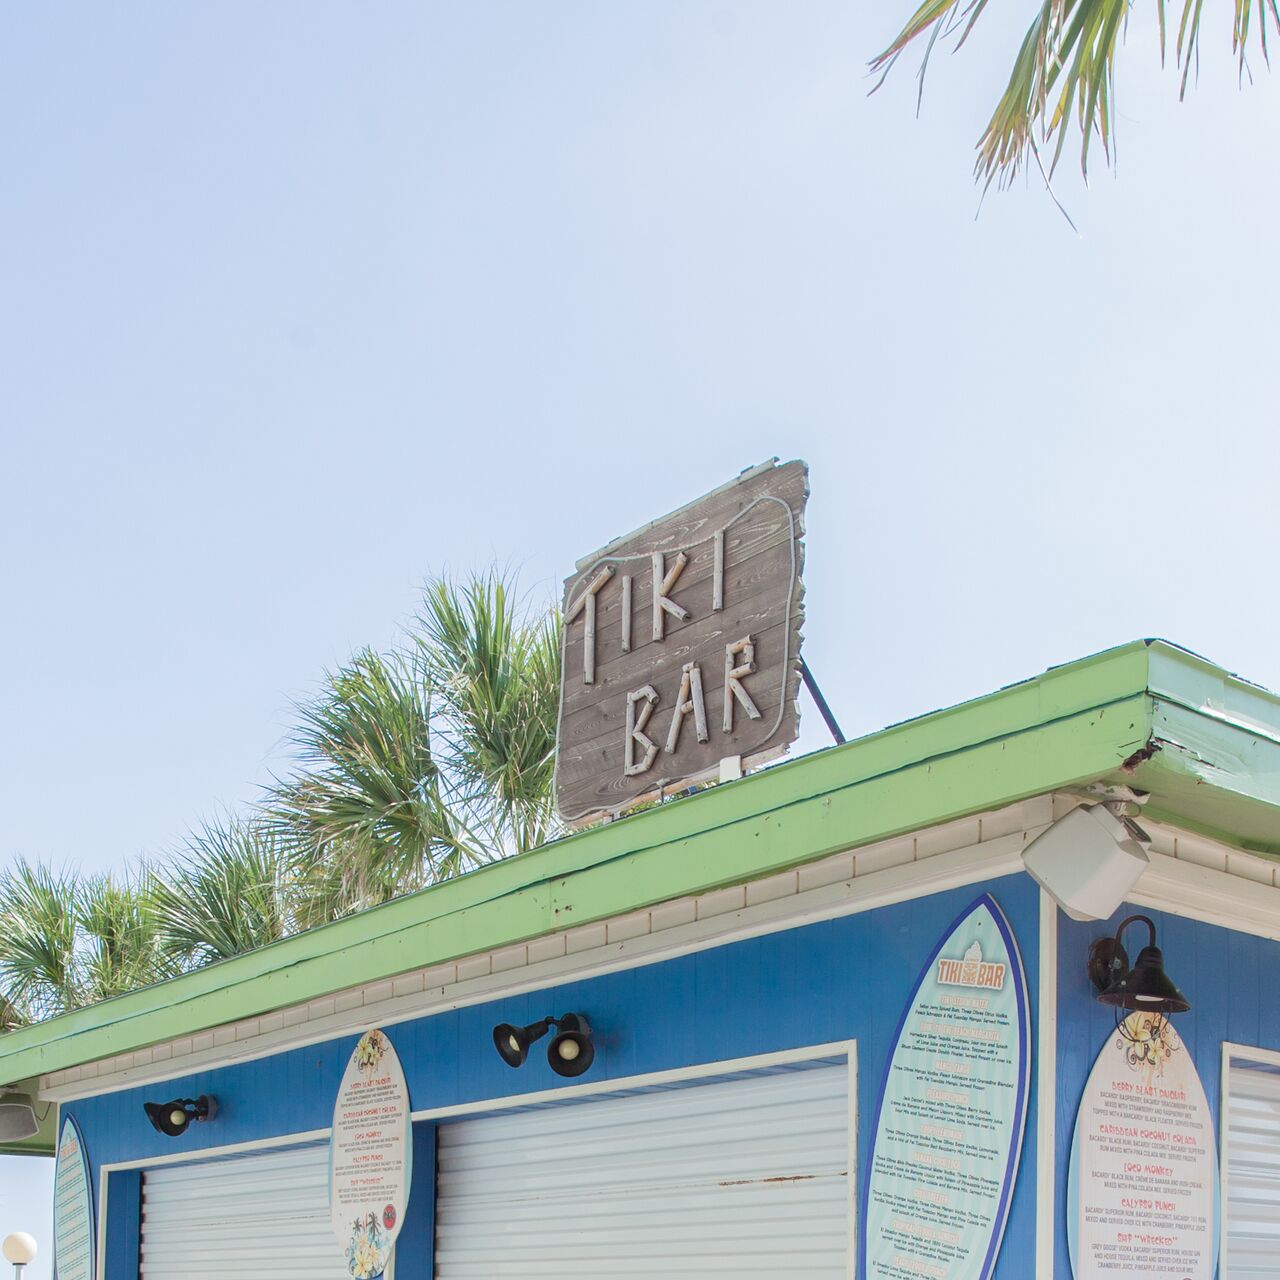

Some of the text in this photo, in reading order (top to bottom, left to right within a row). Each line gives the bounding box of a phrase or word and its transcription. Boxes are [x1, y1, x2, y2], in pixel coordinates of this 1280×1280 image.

[565, 529, 725, 685] TIKI
[623, 634, 762, 777] BAR
[938, 960, 1005, 988] TIKI BAR
[1112, 1081, 1133, 1092] BERRY
[1136, 1084, 1156, 1097] BLAST
[1100, 1124, 1196, 1145] CARIBBEAN COCONUT COLADA
[1124, 1162, 1174, 1177] LOCO MONKEY
[1122, 1197, 1176, 1212] CALYPSO PUNCH
[1117, 1233, 1132, 1243] SHIP
